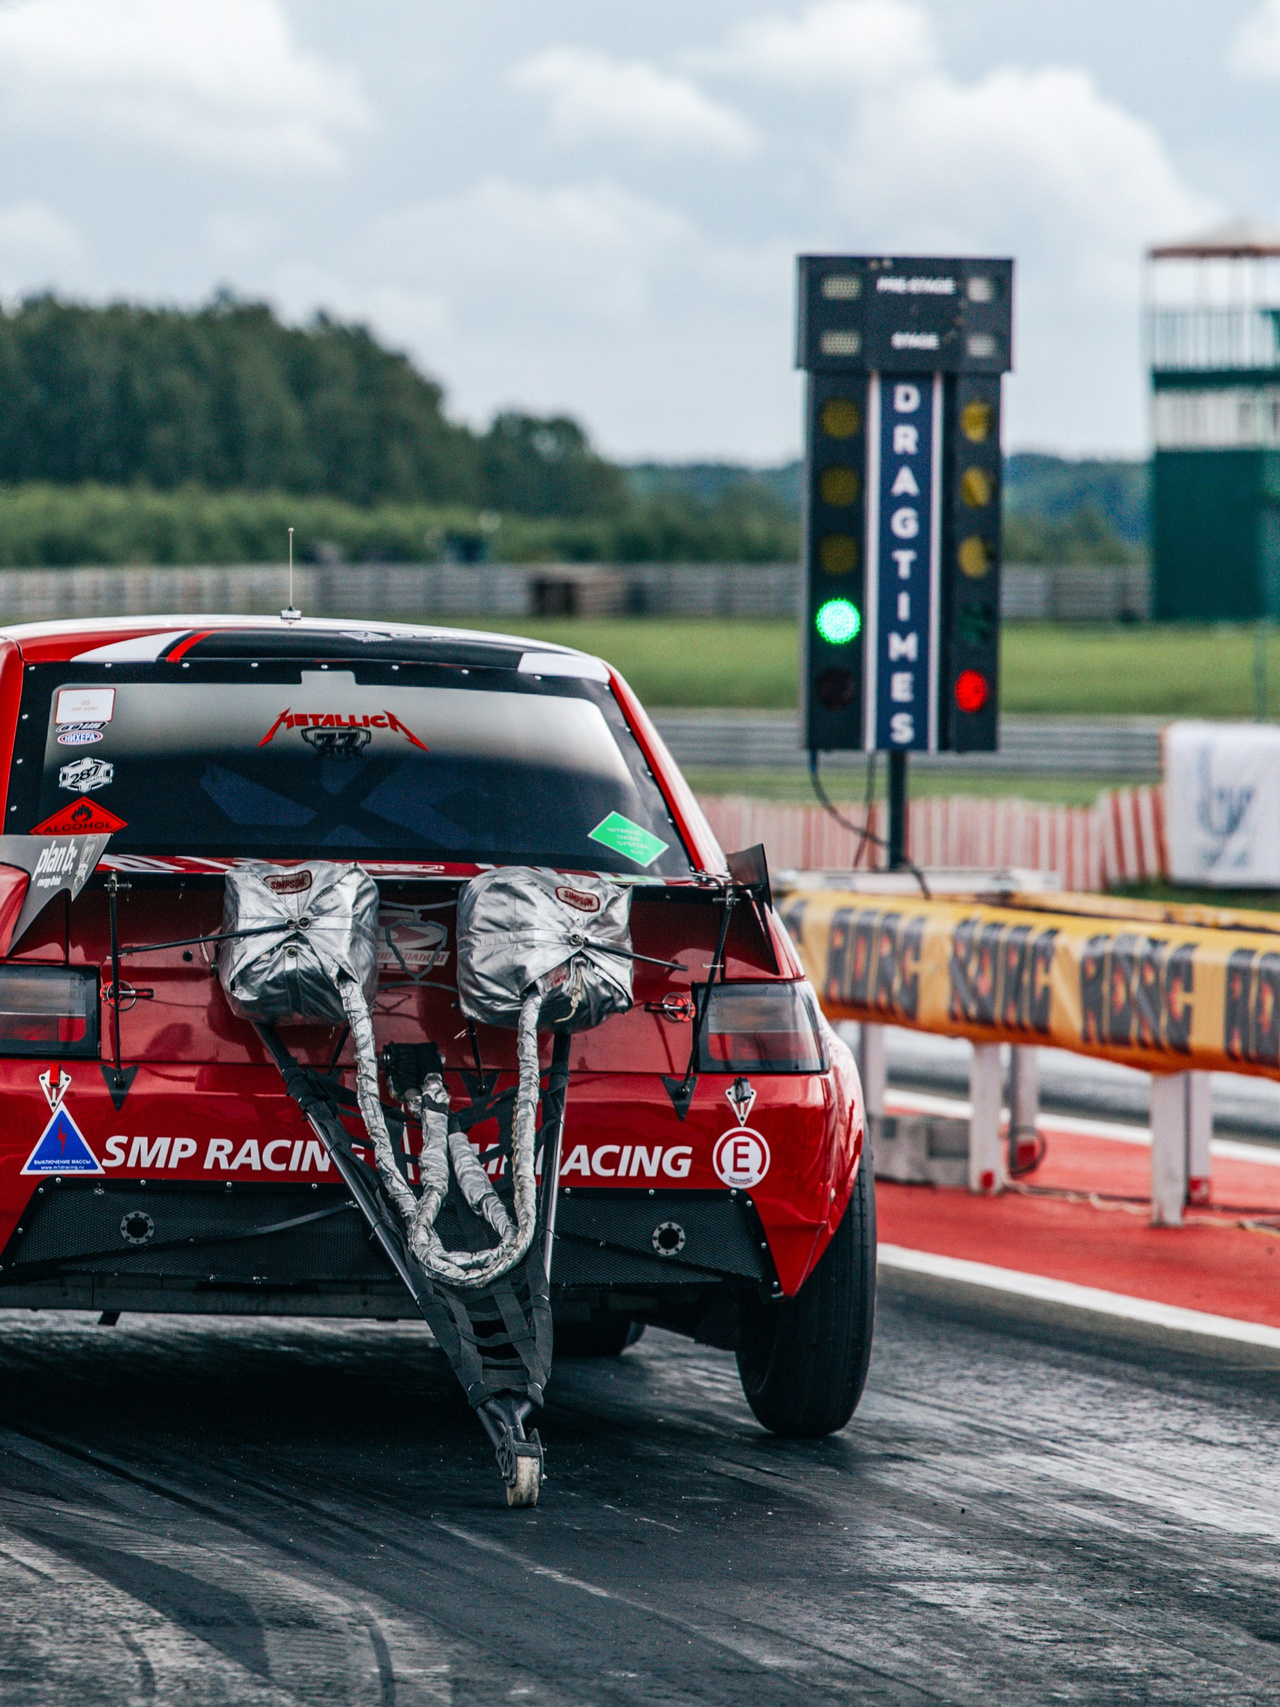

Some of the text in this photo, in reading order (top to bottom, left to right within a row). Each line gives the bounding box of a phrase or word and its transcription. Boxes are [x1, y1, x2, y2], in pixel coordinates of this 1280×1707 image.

[888, 384, 921, 744] DRAGTIMES
[258, 707, 430, 752] METALLICA
[314, 732, 359, 748] 77
[70, 765, 100, 785] 287
[43, 822, 112, 834] ALCOHOL
[270, 877, 305, 890] SIMPSON
[563, 890, 594, 906] SIMPSON
[101, 1135, 365, 1172] SMP RACIN
[536, 1144, 693, 1178] ACING
[733, 1142, 750, 1172] E
